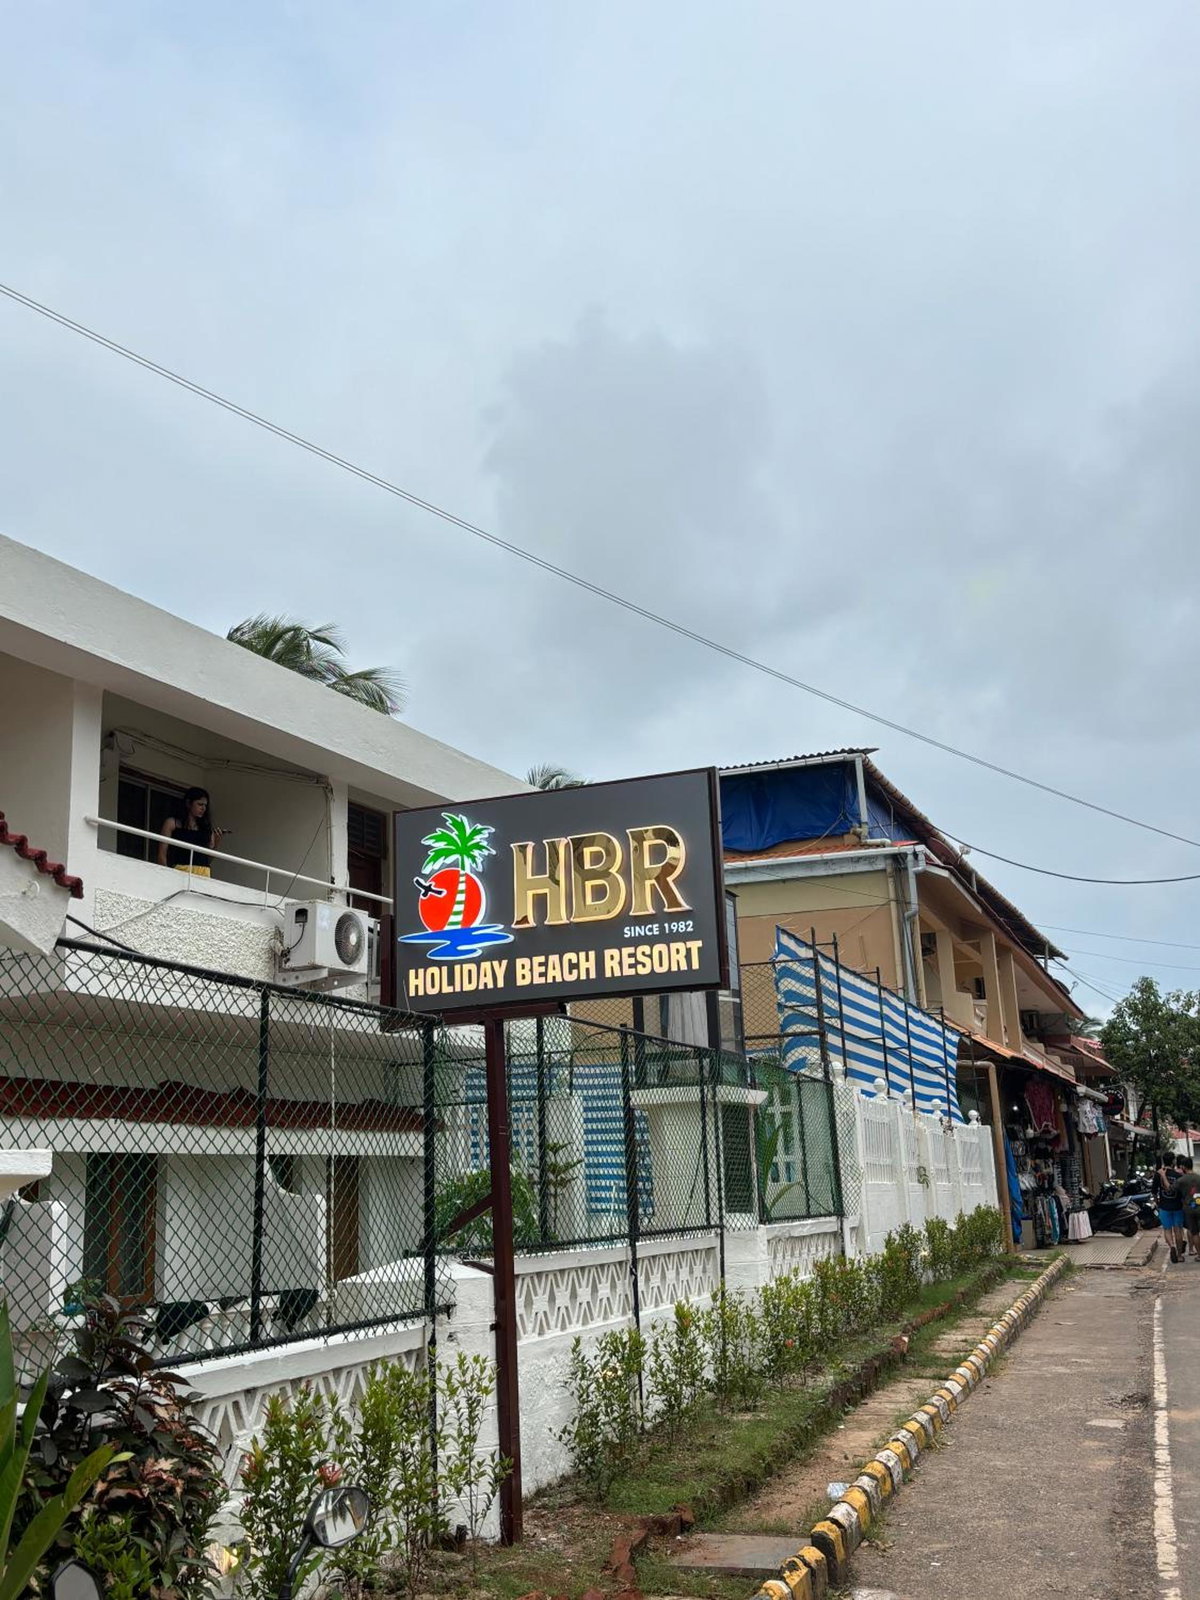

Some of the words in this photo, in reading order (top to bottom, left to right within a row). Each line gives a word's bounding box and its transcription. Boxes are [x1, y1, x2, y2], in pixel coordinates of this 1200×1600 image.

[511, 825, 692, 928] HBR
[623, 924, 659, 938] SINCE
[664, 920, 693, 933] 1982
[409, 960, 508, 996] HOLIDAY
[515, 951, 596, 986] BEACH
[604, 940, 702, 976] RESORT
